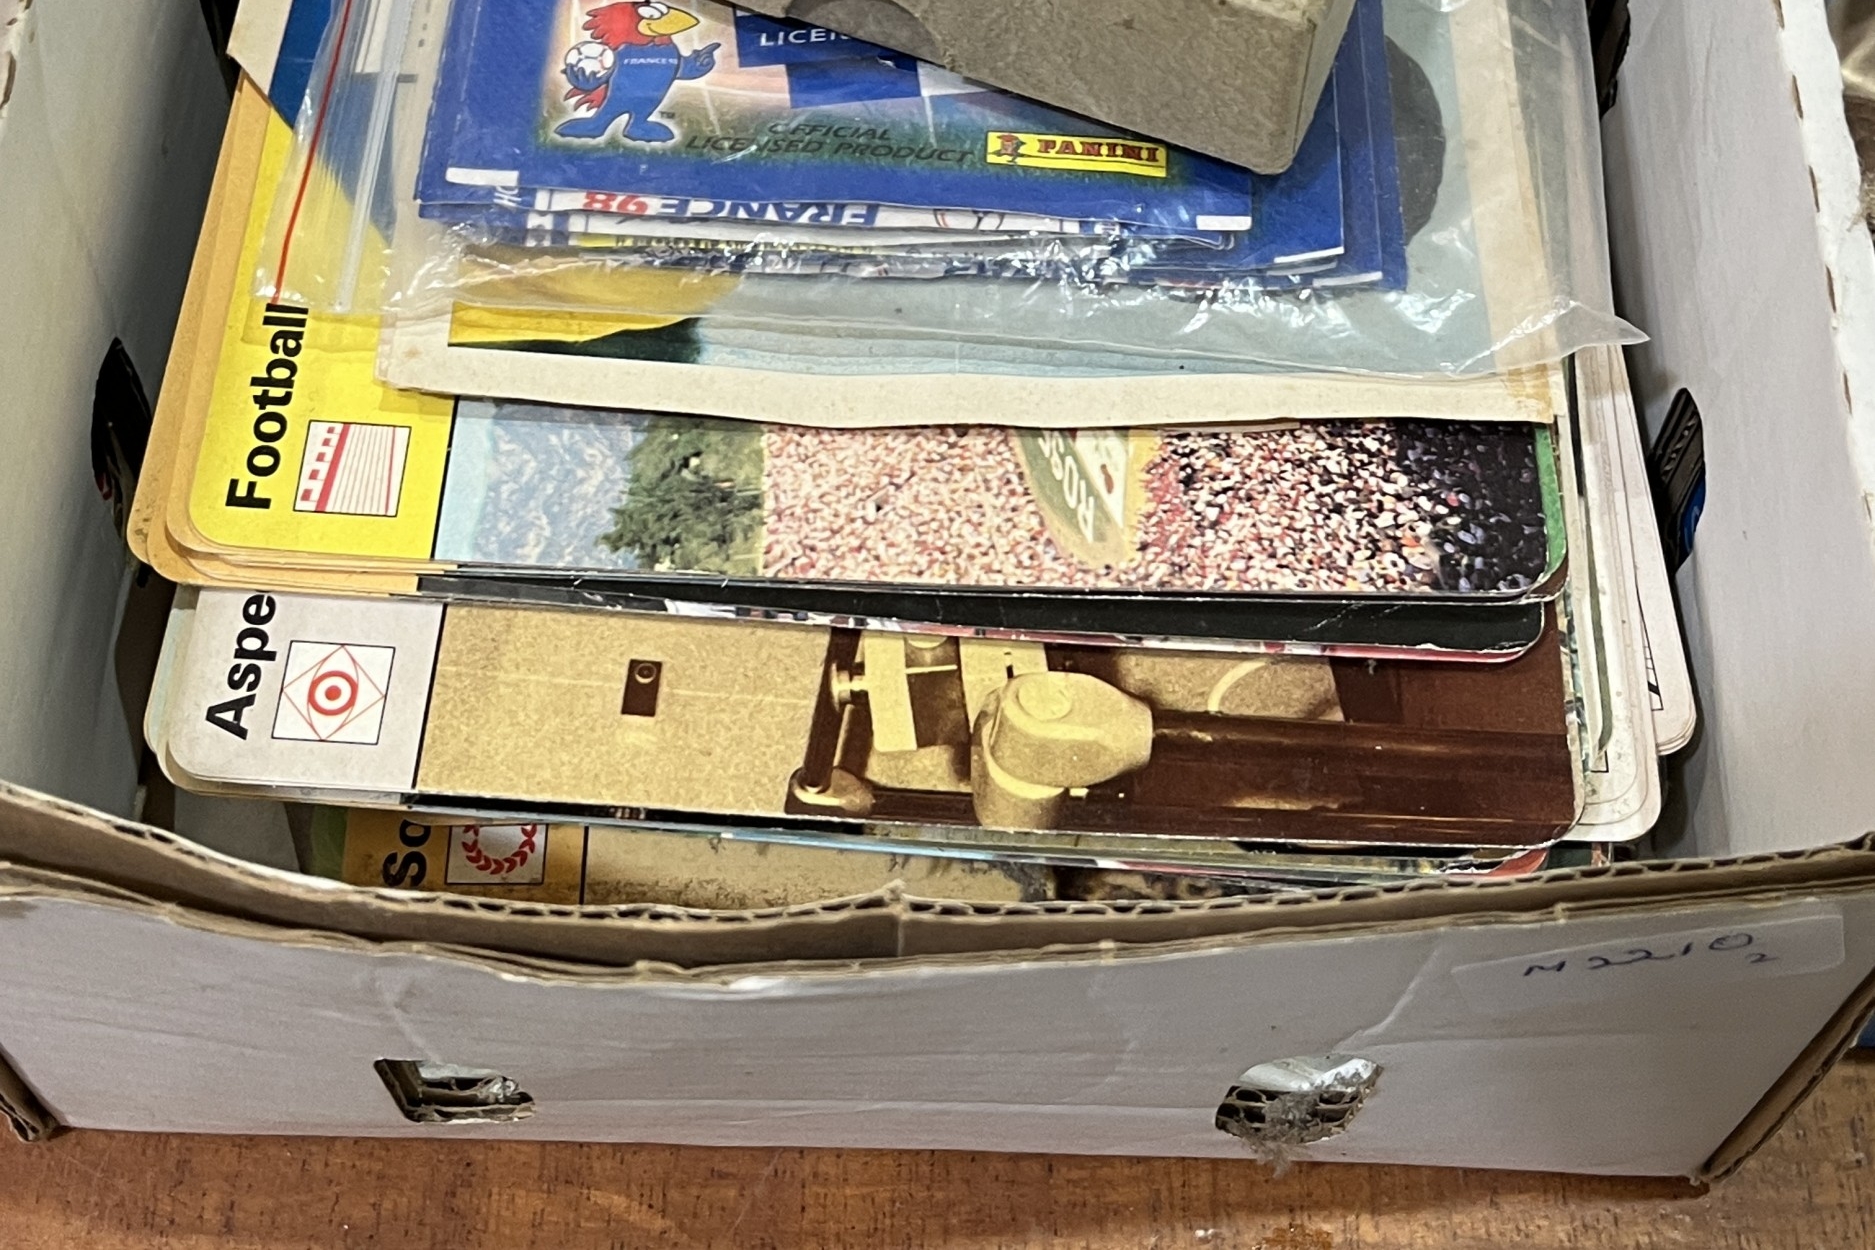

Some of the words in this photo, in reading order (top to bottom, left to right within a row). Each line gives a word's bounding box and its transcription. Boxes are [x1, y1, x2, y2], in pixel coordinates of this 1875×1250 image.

[623, 57, 667, 65] FRANCE
[768, 122, 891, 141] OFFICIAL
[686, 135, 823, 157] LICENSED
[834, 141, 976, 163] PRODUCT
[1037, 138, 1160, 163] PANINI
[582, 190, 649, 216] 98
[655, 199, 879, 227] FRANCE
[225, 302, 310, 510] Football
[205, 590, 277, 740] Aspe
